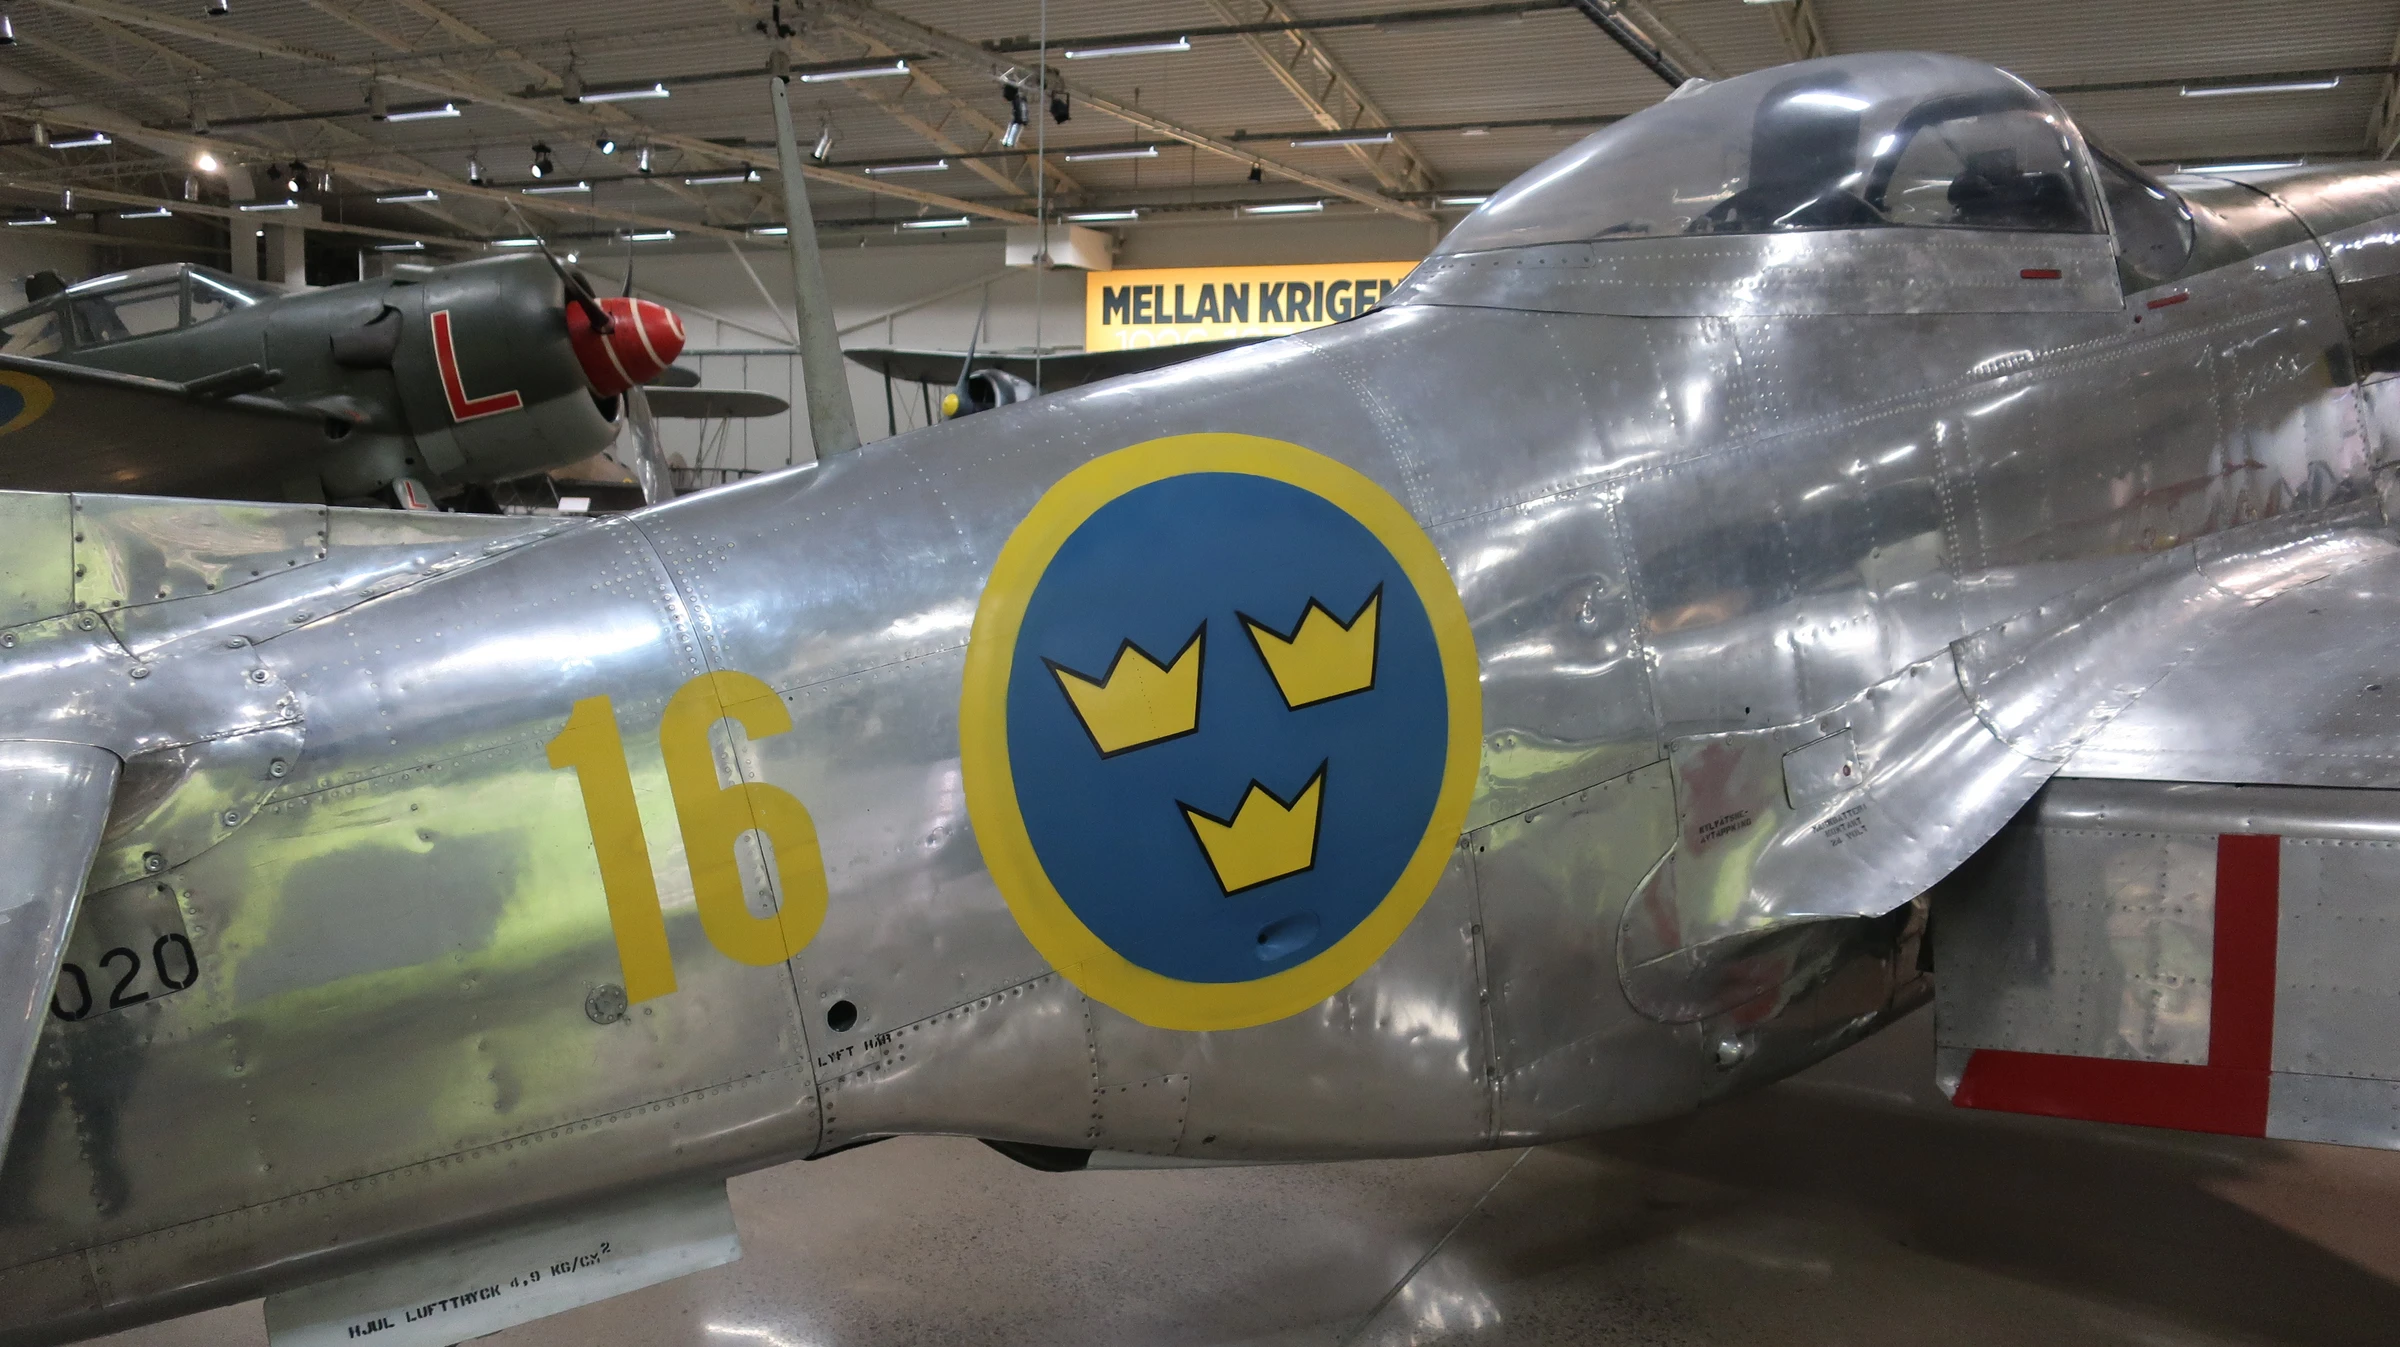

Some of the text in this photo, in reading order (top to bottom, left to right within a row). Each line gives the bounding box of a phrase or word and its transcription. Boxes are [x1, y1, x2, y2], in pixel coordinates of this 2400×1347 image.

[1102, 282, 1250, 326] MELLAN
[430, 309, 524, 423] L
[404, 479, 428, 509] L
[545, 670, 830, 1006] 16
[51, 933, 199, 1022] 020
[817, 1045, 854, 1068] LYFT
[348, 1316, 395, 1339] HJUL
[406, 1284, 501, 1323] LUFTTRYCK
